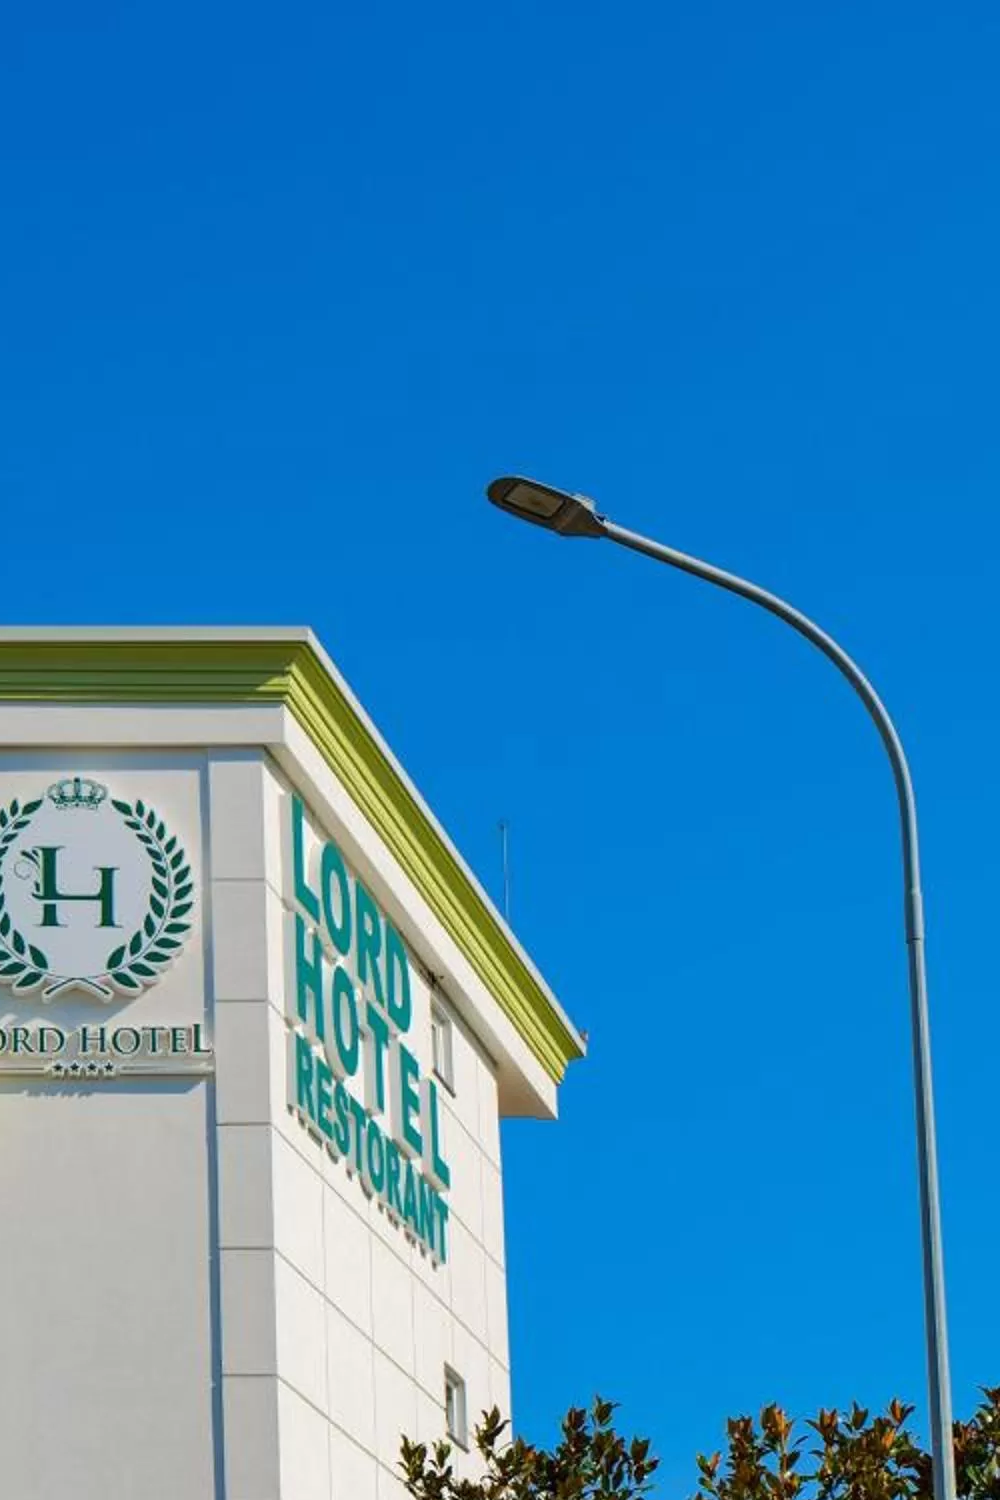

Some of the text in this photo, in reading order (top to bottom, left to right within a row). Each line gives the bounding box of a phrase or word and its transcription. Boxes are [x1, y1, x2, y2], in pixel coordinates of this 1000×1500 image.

[291, 791, 413, 1035] LORD
[81, 1022, 212, 1053] HOTEL
[294, 1030, 449, 1265] RESTORANT
[295, 912, 450, 1190] HOTEL
